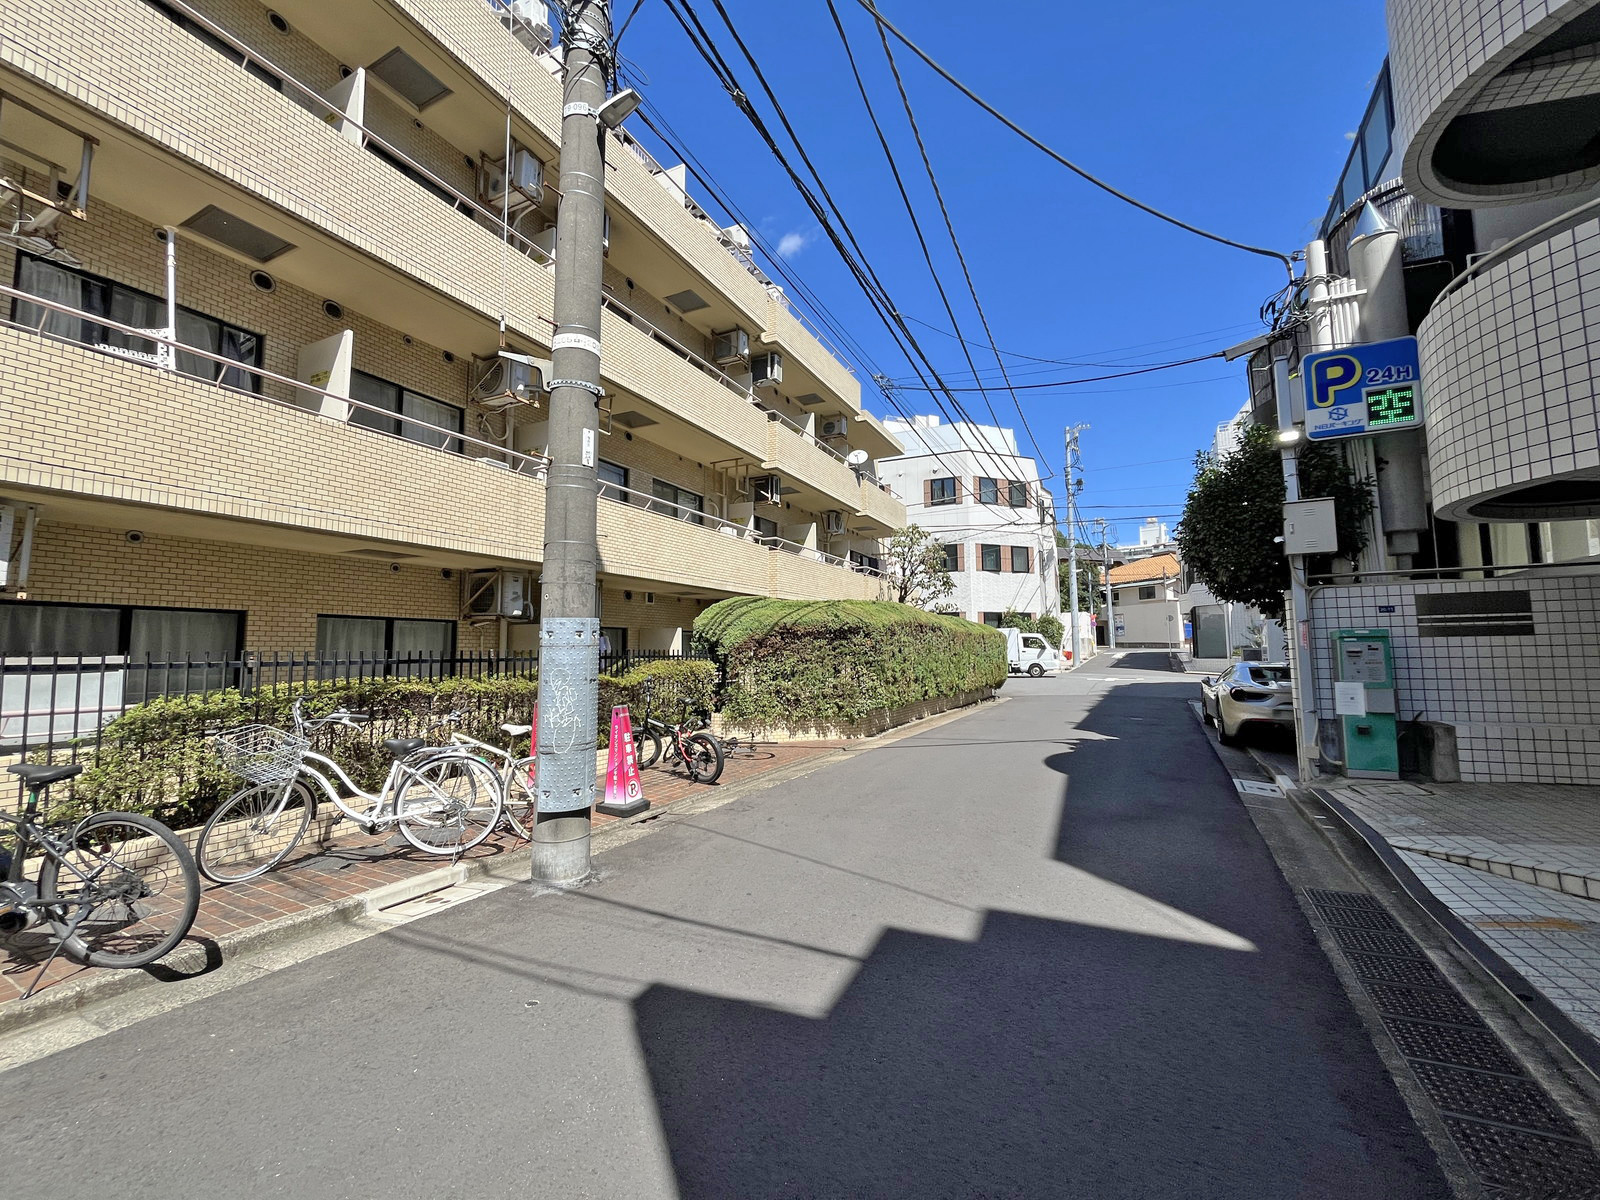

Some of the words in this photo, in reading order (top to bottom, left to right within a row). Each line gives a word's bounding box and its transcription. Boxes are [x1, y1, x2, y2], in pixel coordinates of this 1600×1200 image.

[1312, 354, 1363, 408] P
[1366, 364, 1413, 385] 24H
[1367, 389, 1414, 426] 空
[623, 732, 635, 777] 駐車禁止
